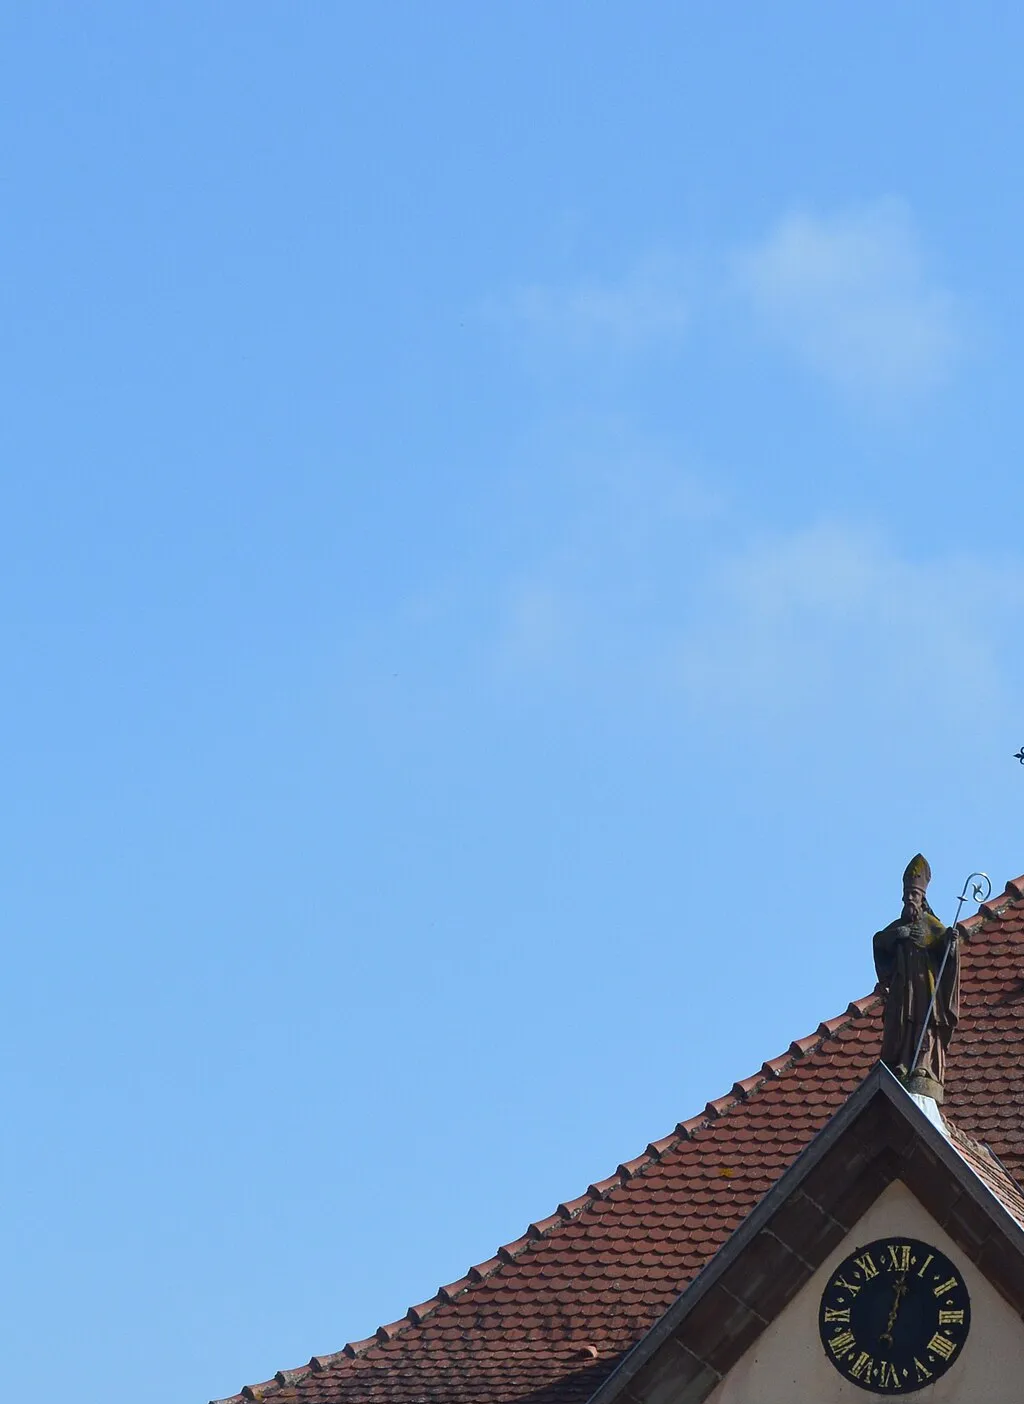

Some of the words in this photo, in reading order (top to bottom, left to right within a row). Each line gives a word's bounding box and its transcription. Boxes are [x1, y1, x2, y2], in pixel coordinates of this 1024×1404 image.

[853, 1252, 880, 1281] XI
[887, 1245, 912, 1271] XII
[917, 1254, 934, 1277] I
[833, 1274, 861, 1297] X
[933, 1277, 958, 1298] II
[824, 1307, 851, 1323] IX
[939, 1309, 965, 1325] III
[828, 1331, 857, 1361] VIII
[848, 1351, 874, 1383] VII
[878, 1360, 902, 1388] VI
[913, 1356, 933, 1382] V
